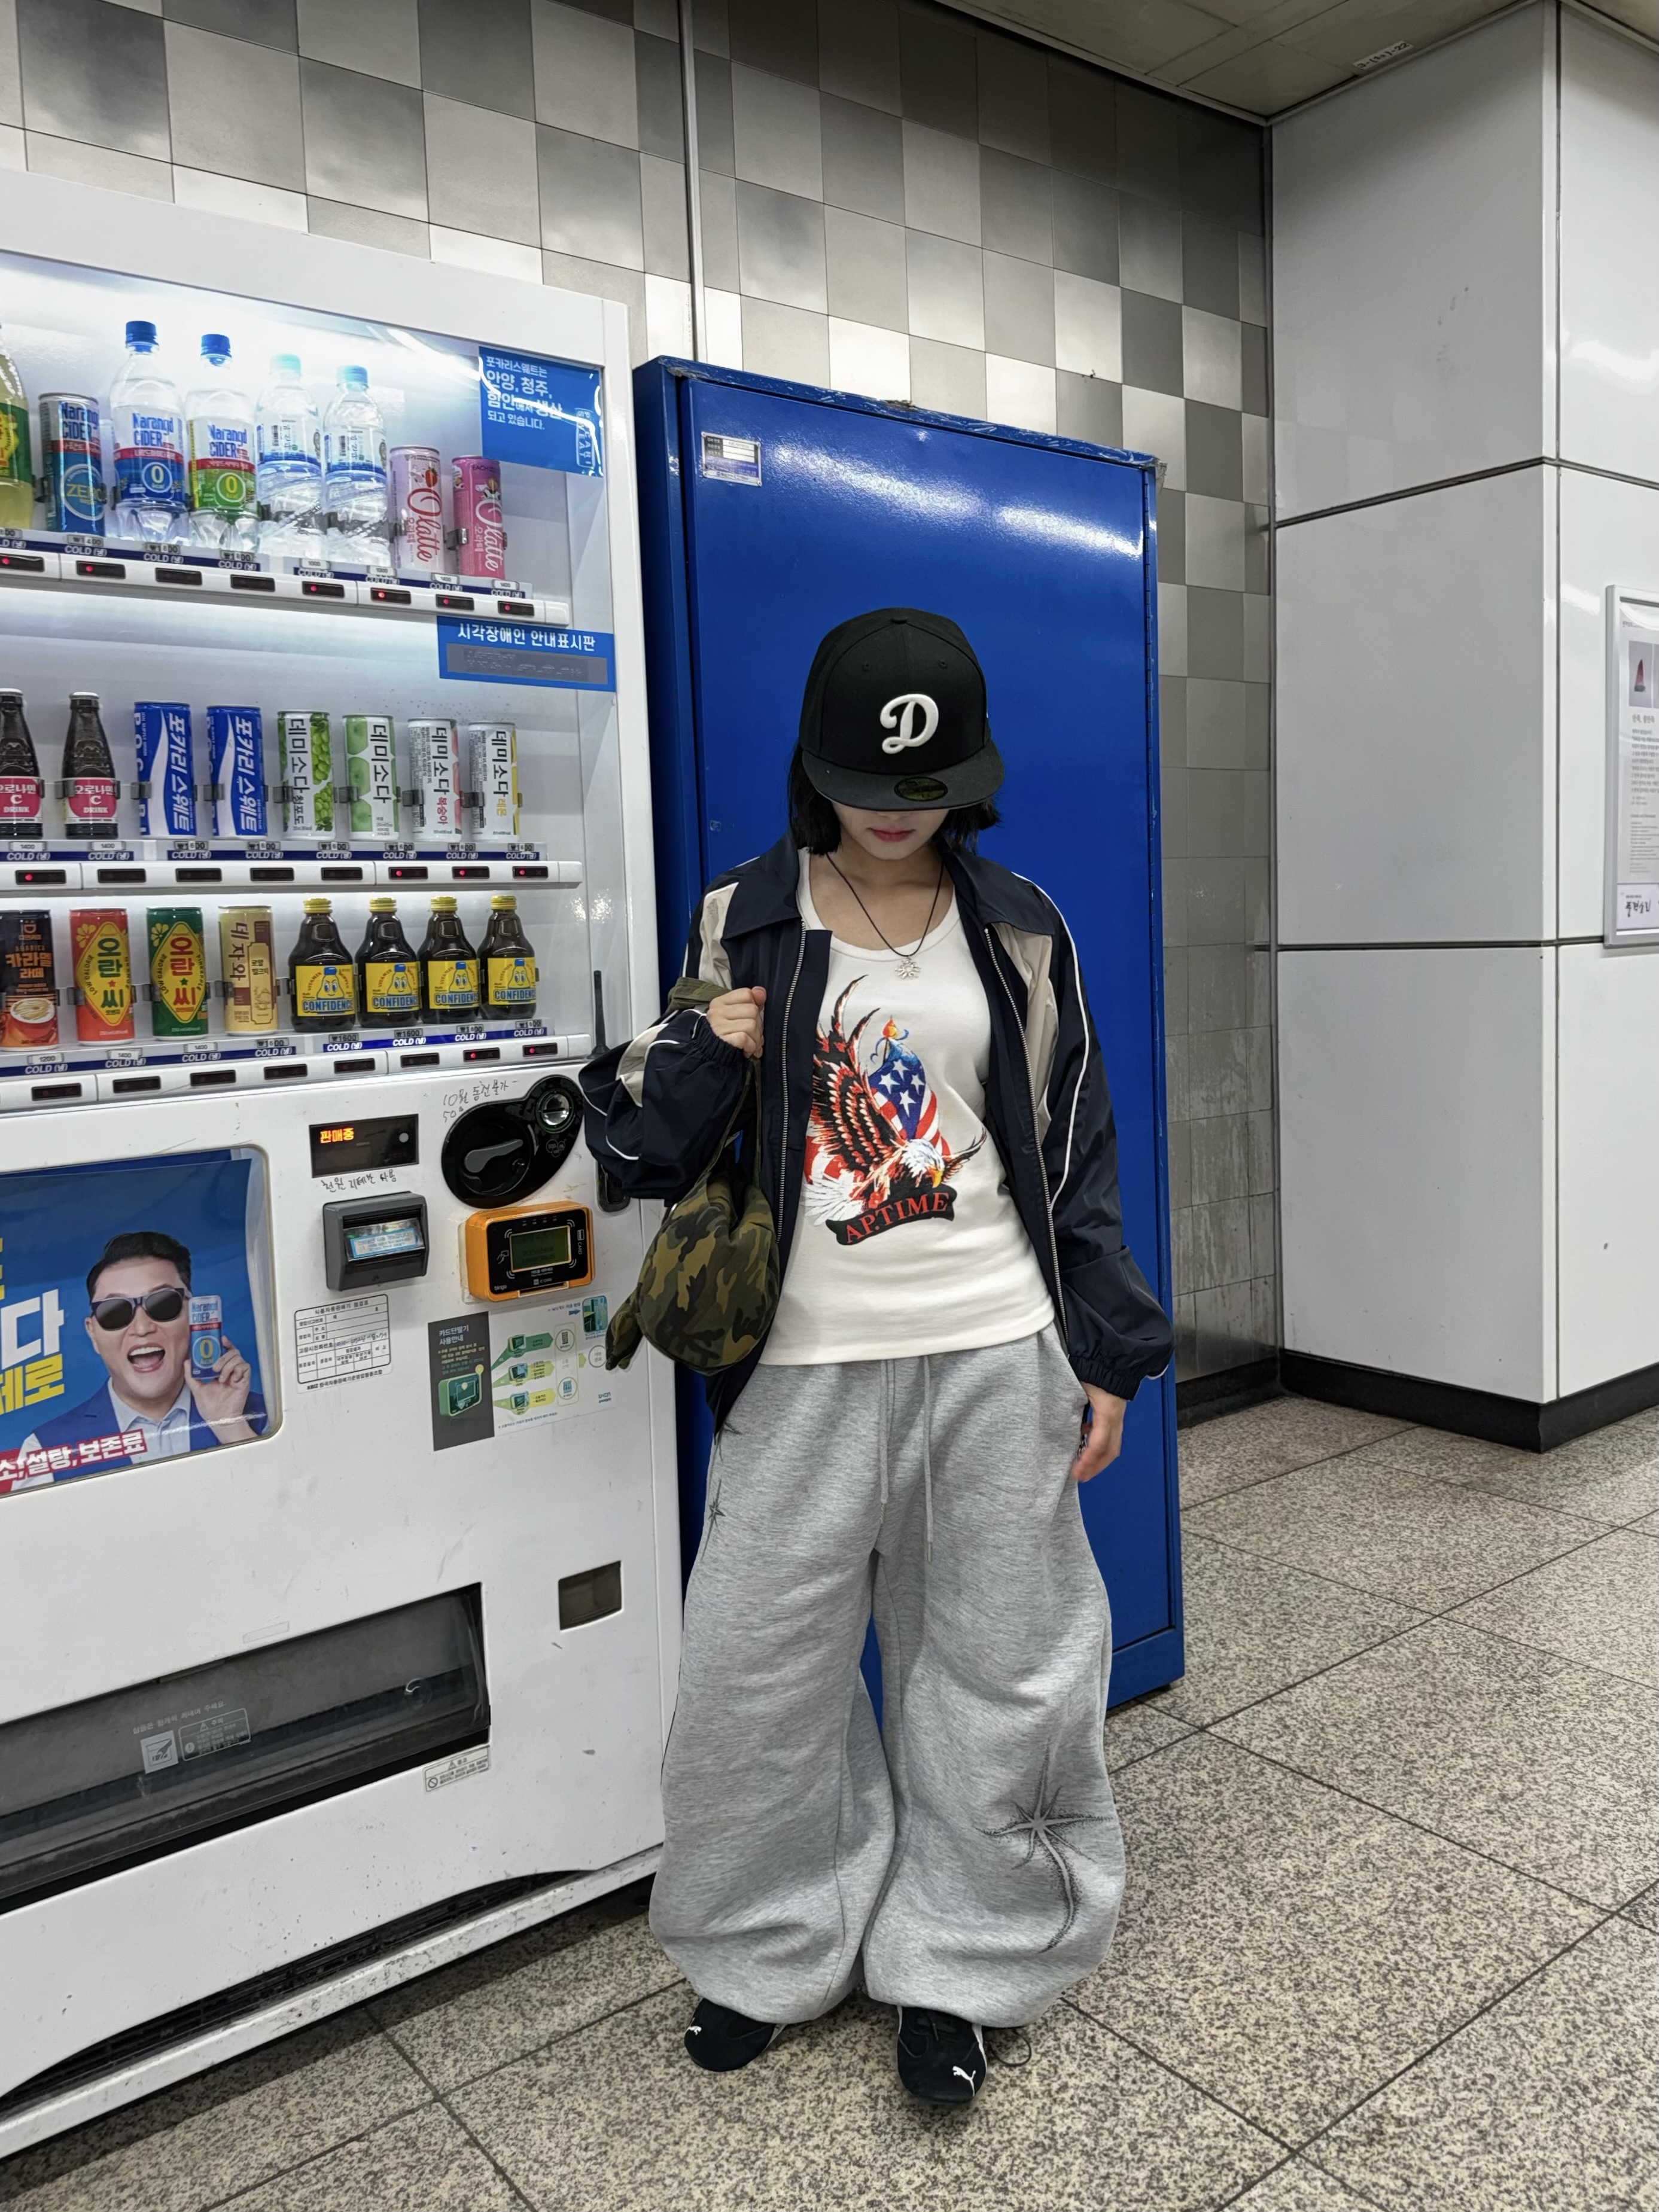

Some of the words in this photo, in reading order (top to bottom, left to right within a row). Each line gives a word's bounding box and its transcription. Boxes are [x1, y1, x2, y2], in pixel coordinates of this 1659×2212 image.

[486, 355, 547, 378] 포카리스웨트는
[486, 370, 519, 392] 안양,
[520, 376, 553, 399] 청주,
[132, 413, 174, 435] Narangd
[487, 409, 506, 423] 되고
[507, 413, 545, 430] 있습니다.
[208, 424, 247, 446] Narangd
[151, 465, 164, 483] 0
[226, 476, 238, 493] 0
[65, 545, 92, 556] COLD
[144, 552, 169, 563] COLD
[218, 560, 243, 569] COLD
[430, 582, 451, 591] COLD
[491, 589, 512, 598] COLD
[458, 623, 526, 645] 시각장애인
[530, 630, 596, 652] 안내표시판
[880, 694, 939, 754] D
[288, 718, 311, 794] 데미소다
[431, 727, 450, 796] 데미소다
[491, 730, 509, 797] 데미소다
[370, 724, 392, 804] 데미소다
[168, 712, 190, 832] 포카리스웨트
[235, 715, 258, 832] 포카리스웨트
[10, 794, 23, 805] C
[90, 795, 102, 805] C
[436, 796, 448, 825] 복숭아
[497, 798, 507, 817] 레몬
[7, 852, 35, 861] COLD
[88, 852, 115, 861] COLD
[172, 851, 197, 859] COLD
[228, 922, 249, 981] 데자와
[5, 952, 52, 967] 카라멜
[19, 967, 45, 979] 라떼
[97, 937, 124, 1008] 오란씨
[170, 937, 196, 1006] 오란씨
[302, 1000, 353, 1011] CONFIDENC
[455, 1034, 476, 1042] COLD
[513, 1028, 534, 1037] COLD
[327, 1043, 351, 1052] COLD
[392, 1038, 415, 1047] COLD
[181, 1053, 207, 1063] COLD
[255, 1049, 279, 1057] COLD
[25, 1065, 53, 1074] COLD
[105, 1059, 132, 1068] COLD
[320, 1128, 355, 1144] 판매중
[380, 1169, 397, 1183] 사용
[0, 1288, 65, 1371] 다
[439, 1324, 469, 1336] 카드단말기
[439, 1334, 464, 1345] 사용안내
[200, 1339, 213, 1359] 0
